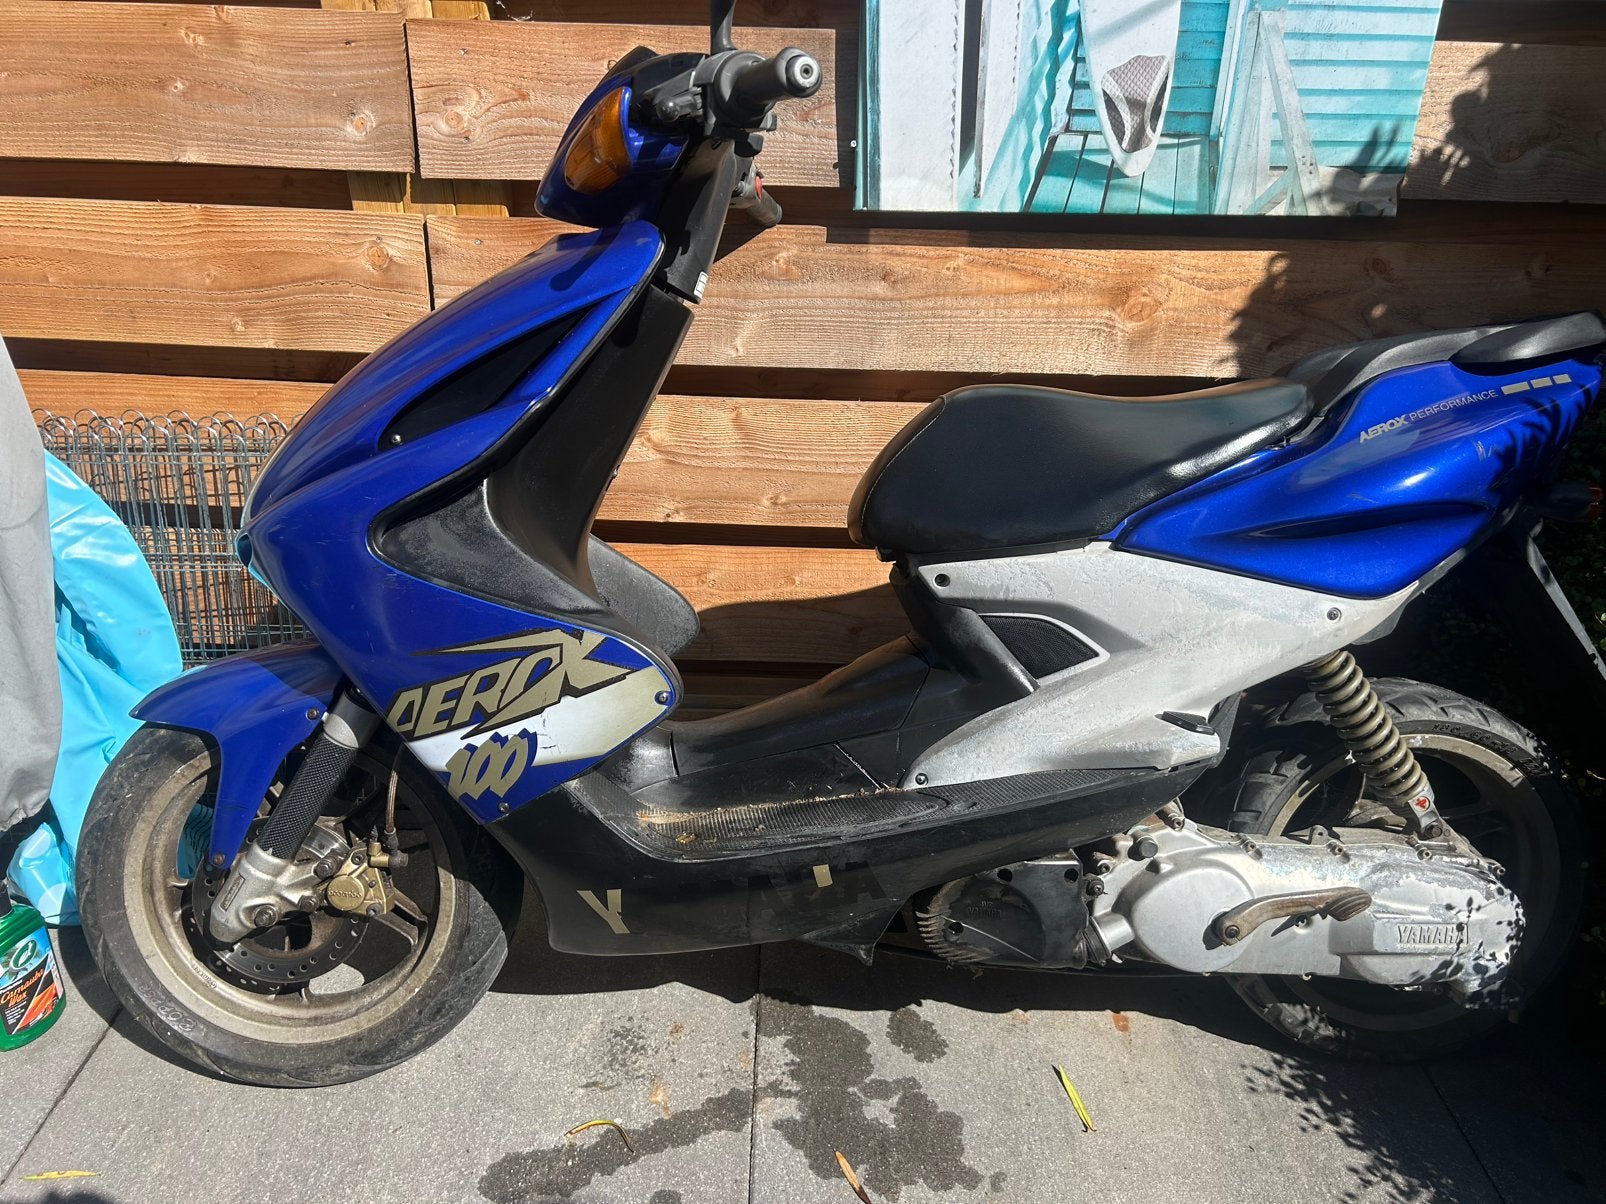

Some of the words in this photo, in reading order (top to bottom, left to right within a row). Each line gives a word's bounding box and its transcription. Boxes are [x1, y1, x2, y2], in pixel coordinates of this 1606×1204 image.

[1359, 414, 1408, 443] AEROX
[1409, 389, 1499, 421] PERFORMANCE
[386, 628, 635, 740] AEROX
[445, 733, 531, 800] 100
[1397, 925, 1469, 944] YAMAHA
[9, 991, 27, 1007] Wax
